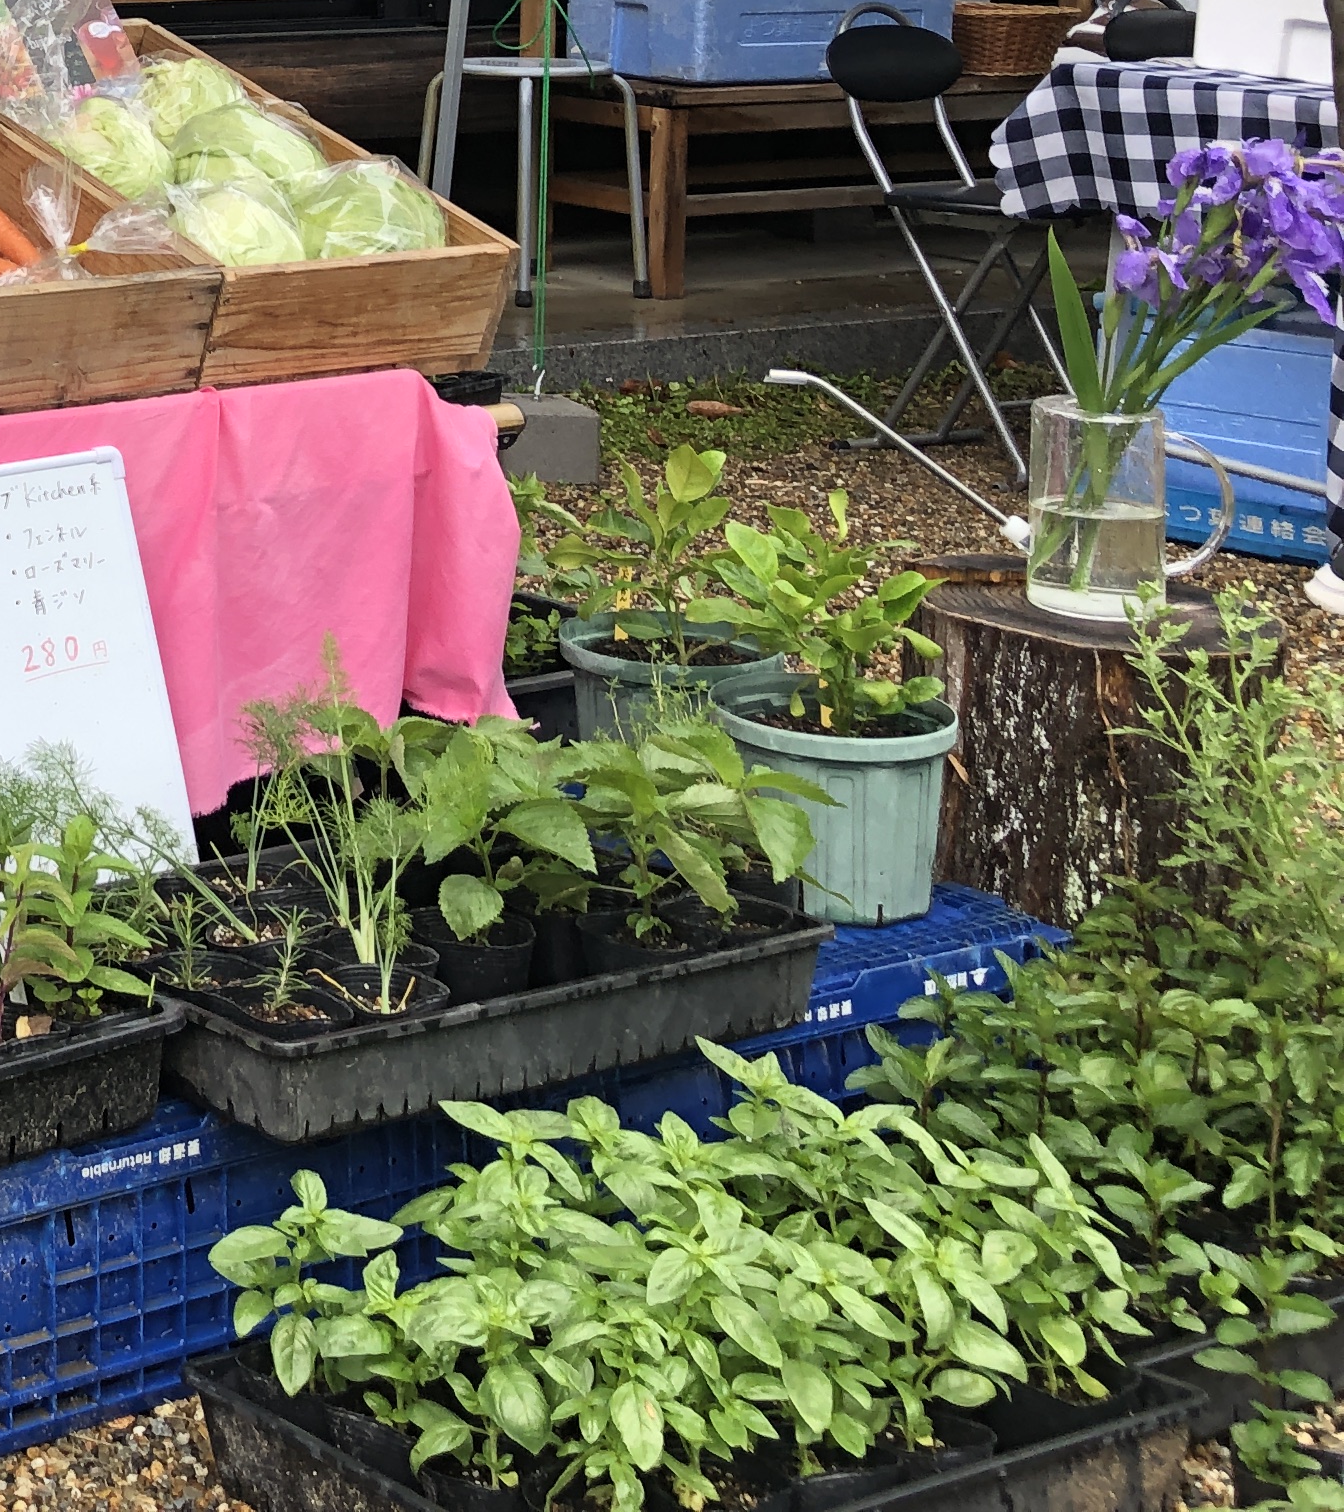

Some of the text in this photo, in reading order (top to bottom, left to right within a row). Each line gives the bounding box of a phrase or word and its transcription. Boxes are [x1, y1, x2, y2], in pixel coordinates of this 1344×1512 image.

[22, 523, 88, 550] フェンネル
[24, 552, 107, 580] ローズマリー
[21, 635, 109, 673] 280 円
[923, 970, 969, 996] 自然国
[80, 1137, 201, 1179] 要返却 Returnable
